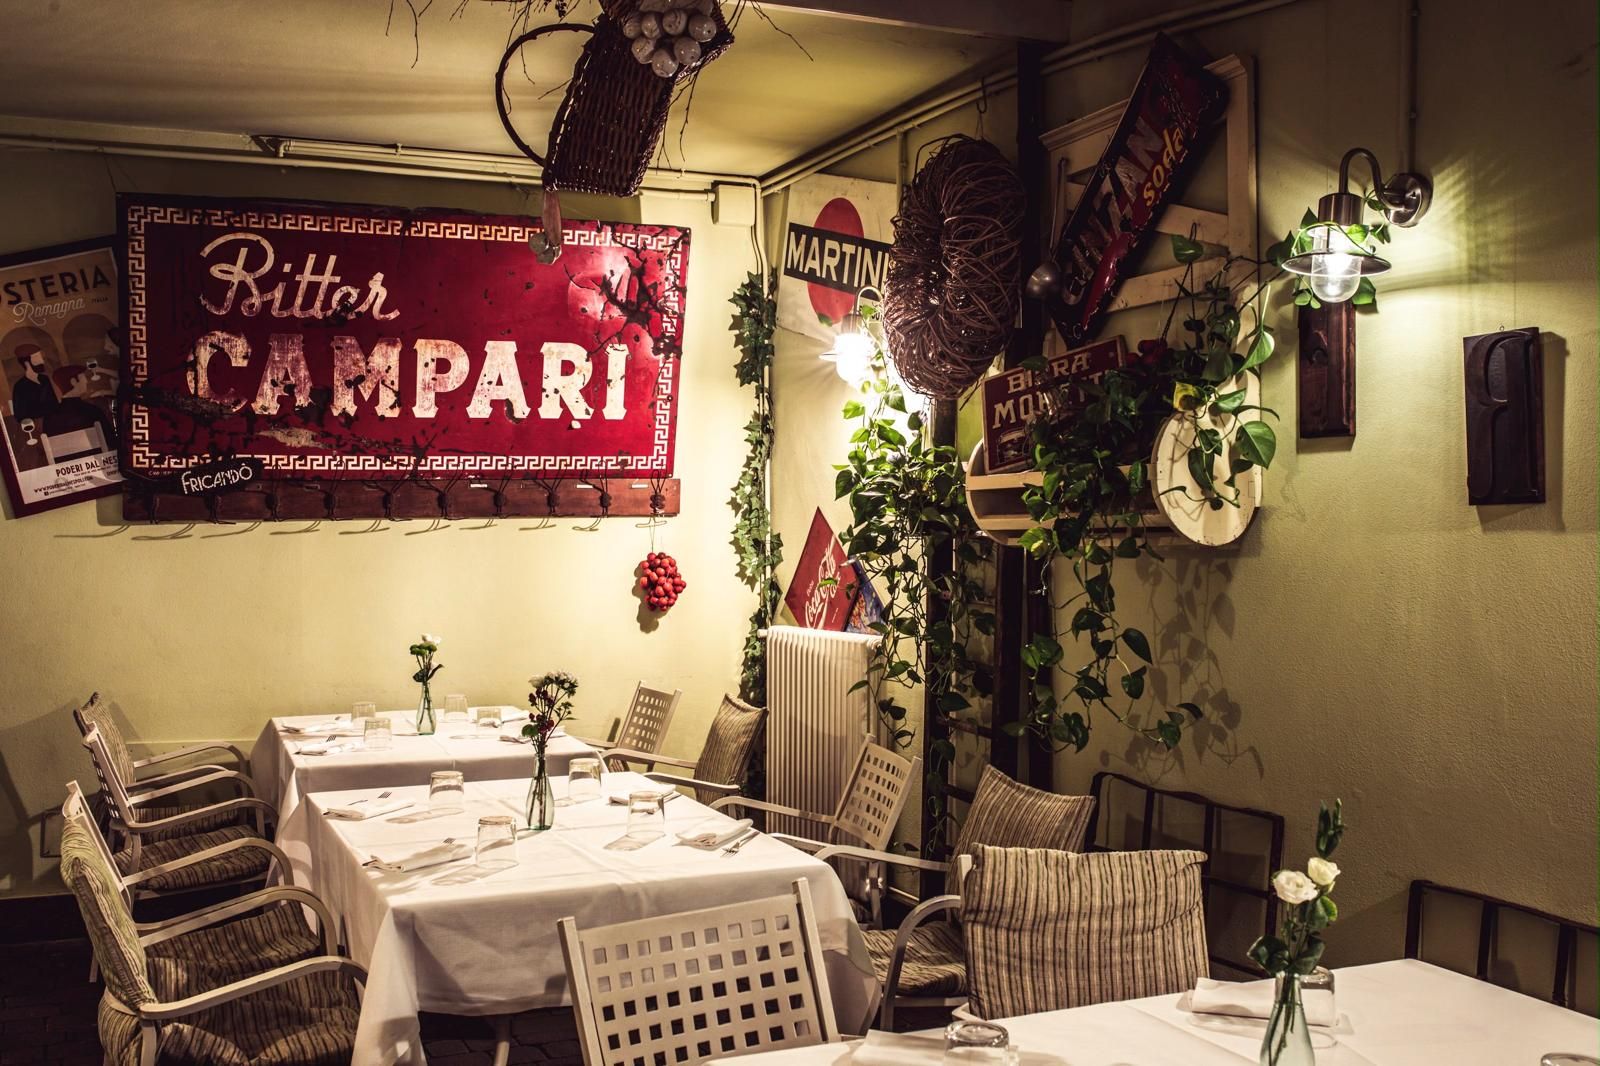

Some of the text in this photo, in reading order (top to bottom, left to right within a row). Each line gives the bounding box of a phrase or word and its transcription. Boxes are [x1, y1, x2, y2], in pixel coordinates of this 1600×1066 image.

[1143, 126, 1184, 207] soda
[0, 264, 112, 306] STERIA
[198, 231, 401, 322] Bitter
[13, 297, 86, 327] Romagna
[186, 329, 628, 421] CAMPARI
[1007, 352, 1092, 394] BIRA
[55, 464, 84, 478] PODERI
[86, 460, 100, 473] DAL
